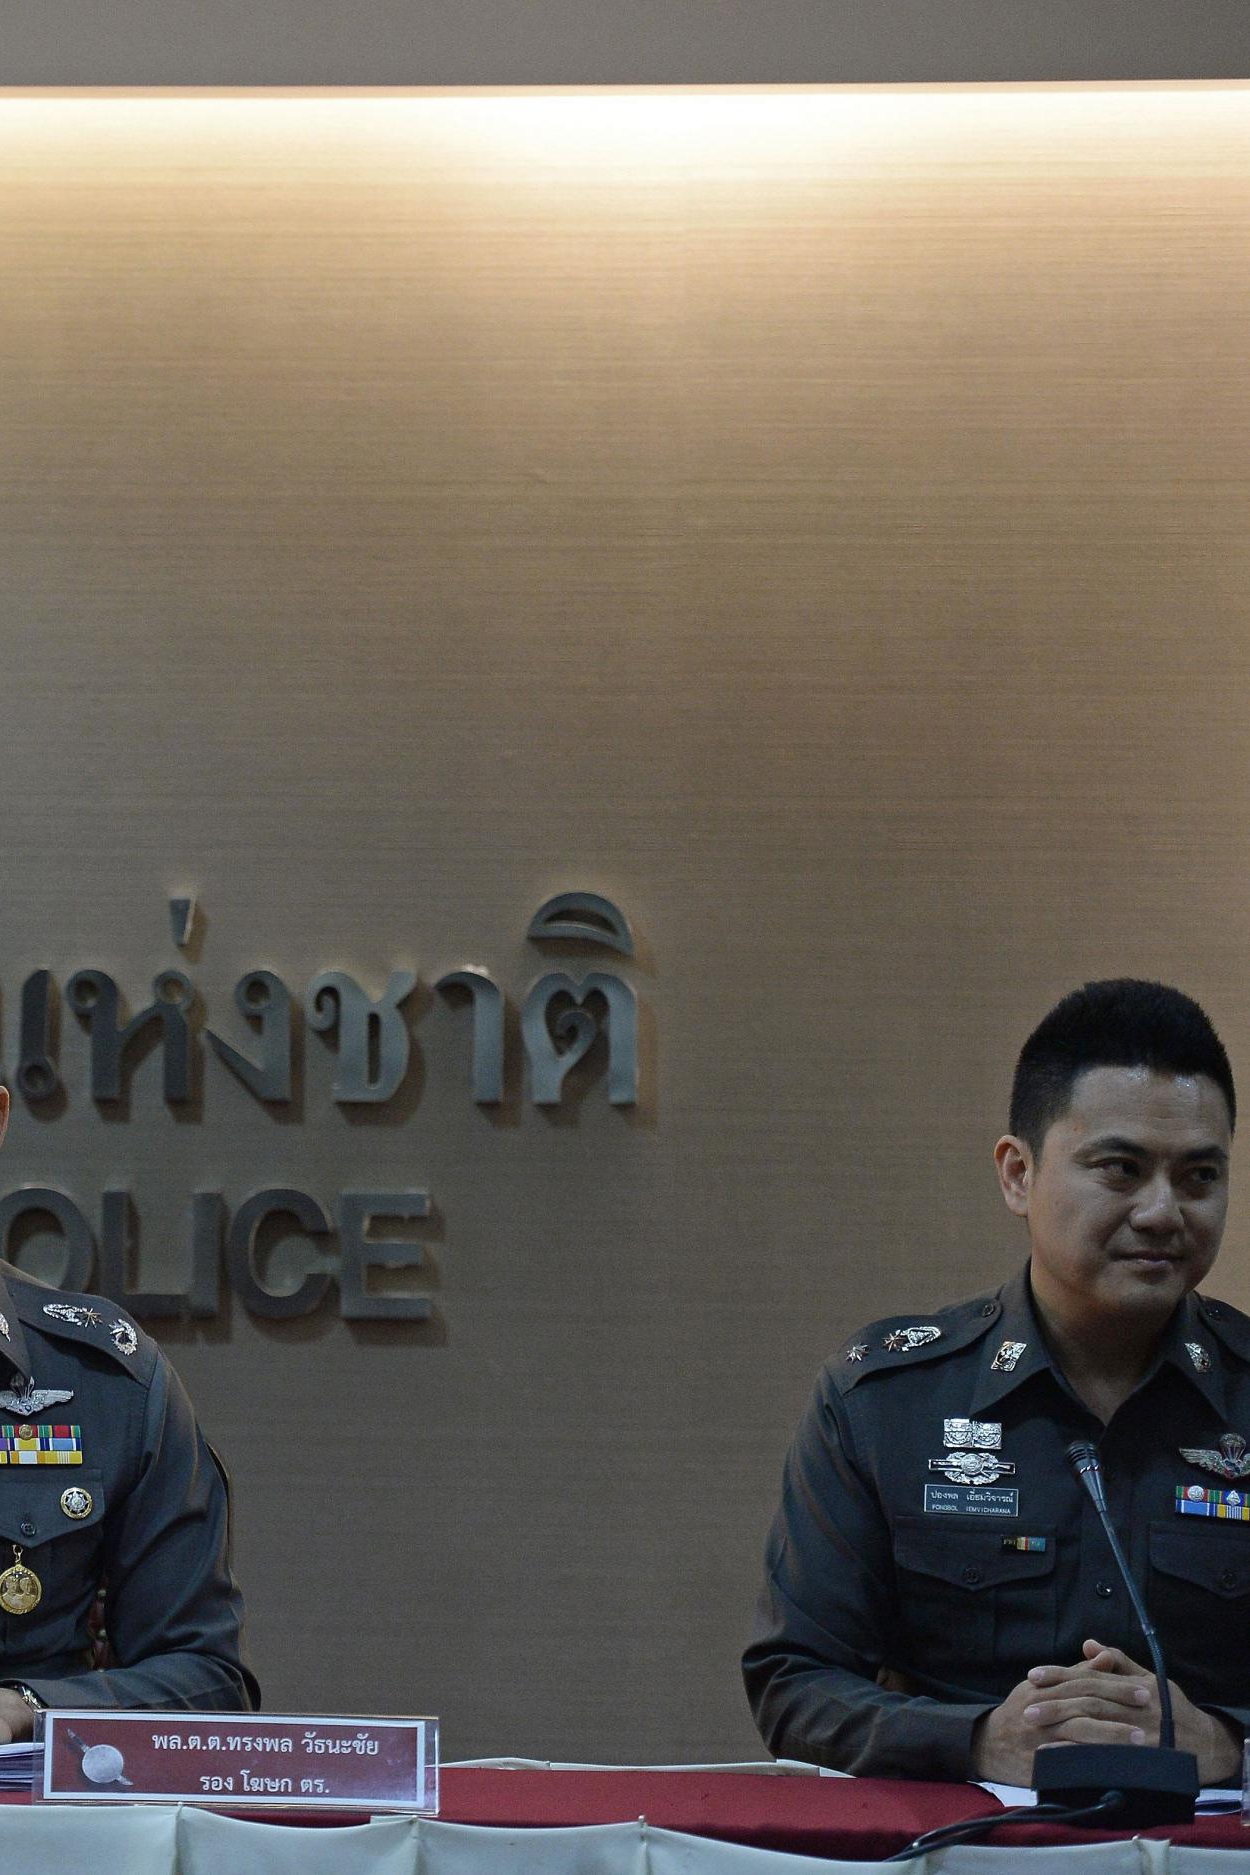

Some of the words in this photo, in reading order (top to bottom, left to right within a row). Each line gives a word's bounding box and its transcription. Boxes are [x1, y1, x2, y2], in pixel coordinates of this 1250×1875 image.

[151, 1733, 293, 1753] พล.ต.ต.ทรงพล
[301, 1731, 379, 1755] วัธนะชัย
[199, 1775, 234, 1792] รอง
[239, 1769, 292, 1793] โฆษก
[300, 1777, 330, 1794] ตร.
